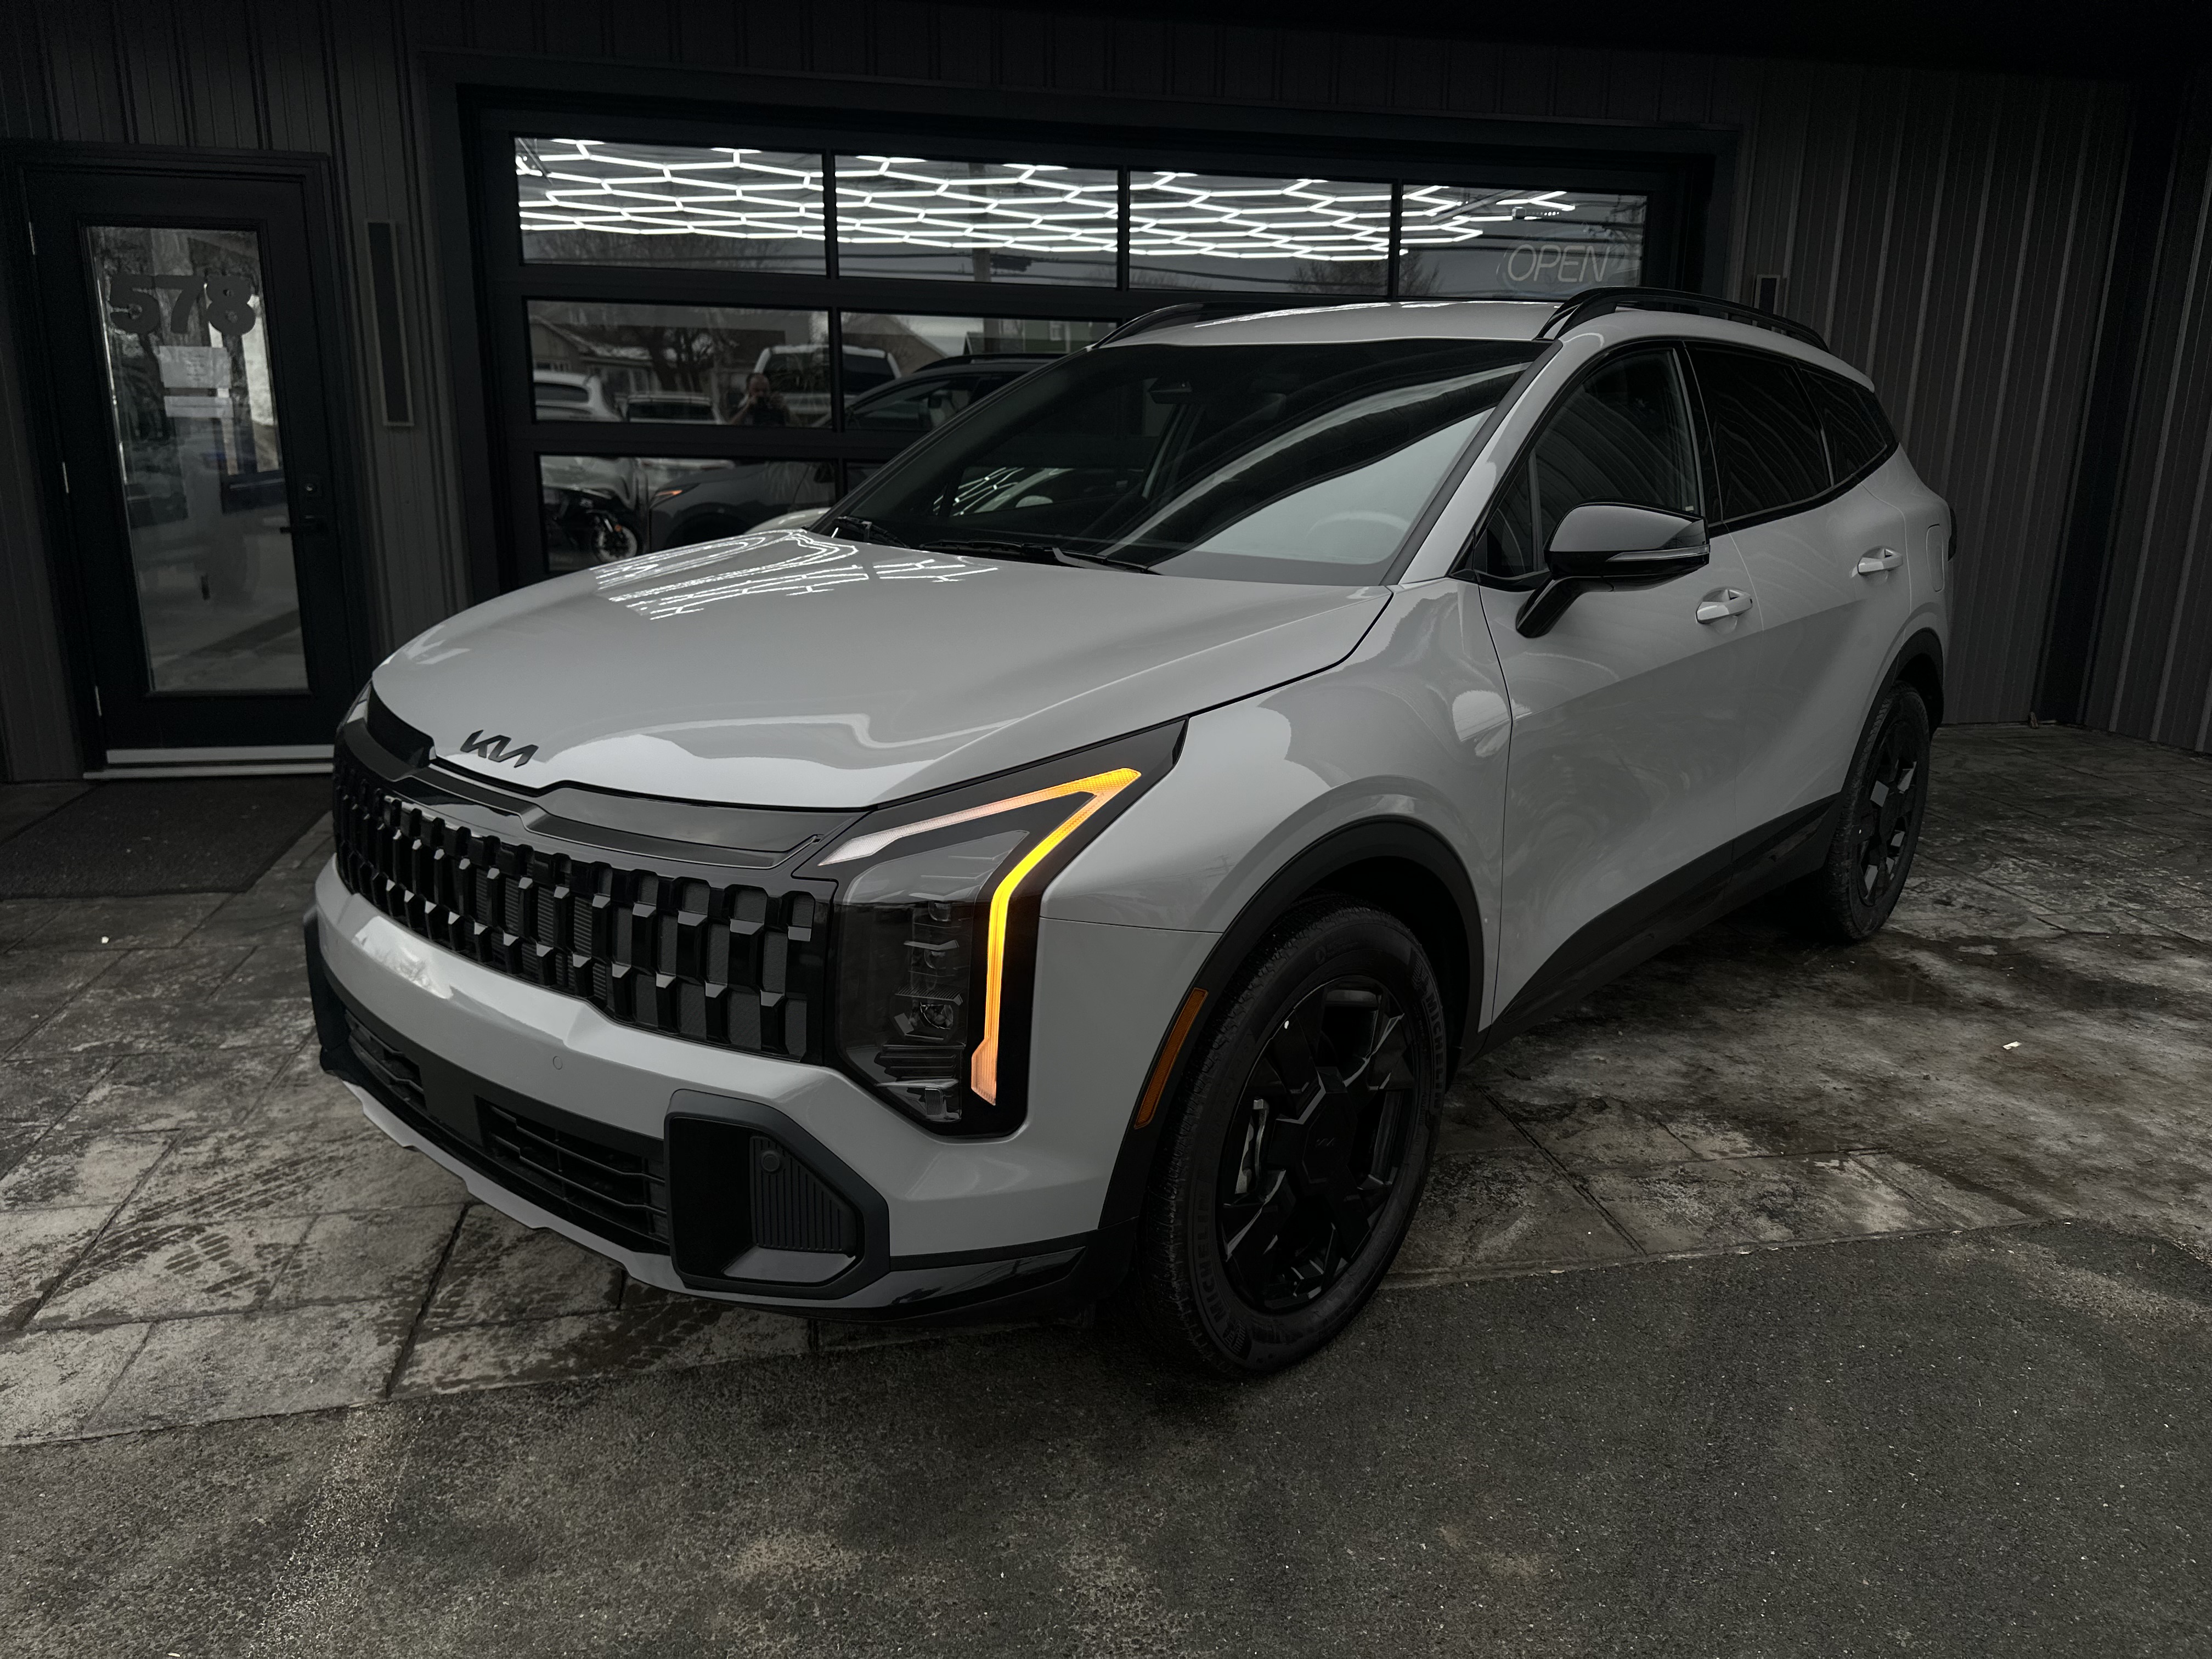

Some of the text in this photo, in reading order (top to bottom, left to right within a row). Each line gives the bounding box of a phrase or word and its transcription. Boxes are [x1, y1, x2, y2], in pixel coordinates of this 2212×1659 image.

[1508, 244, 1610, 282] OPEN
[109, 274, 256, 336] 578
[460, 730, 539, 768] KIA
[1426, 992, 1444, 1110] MICHELIN
[1197, 1190, 1226, 1323] MICHELIN
